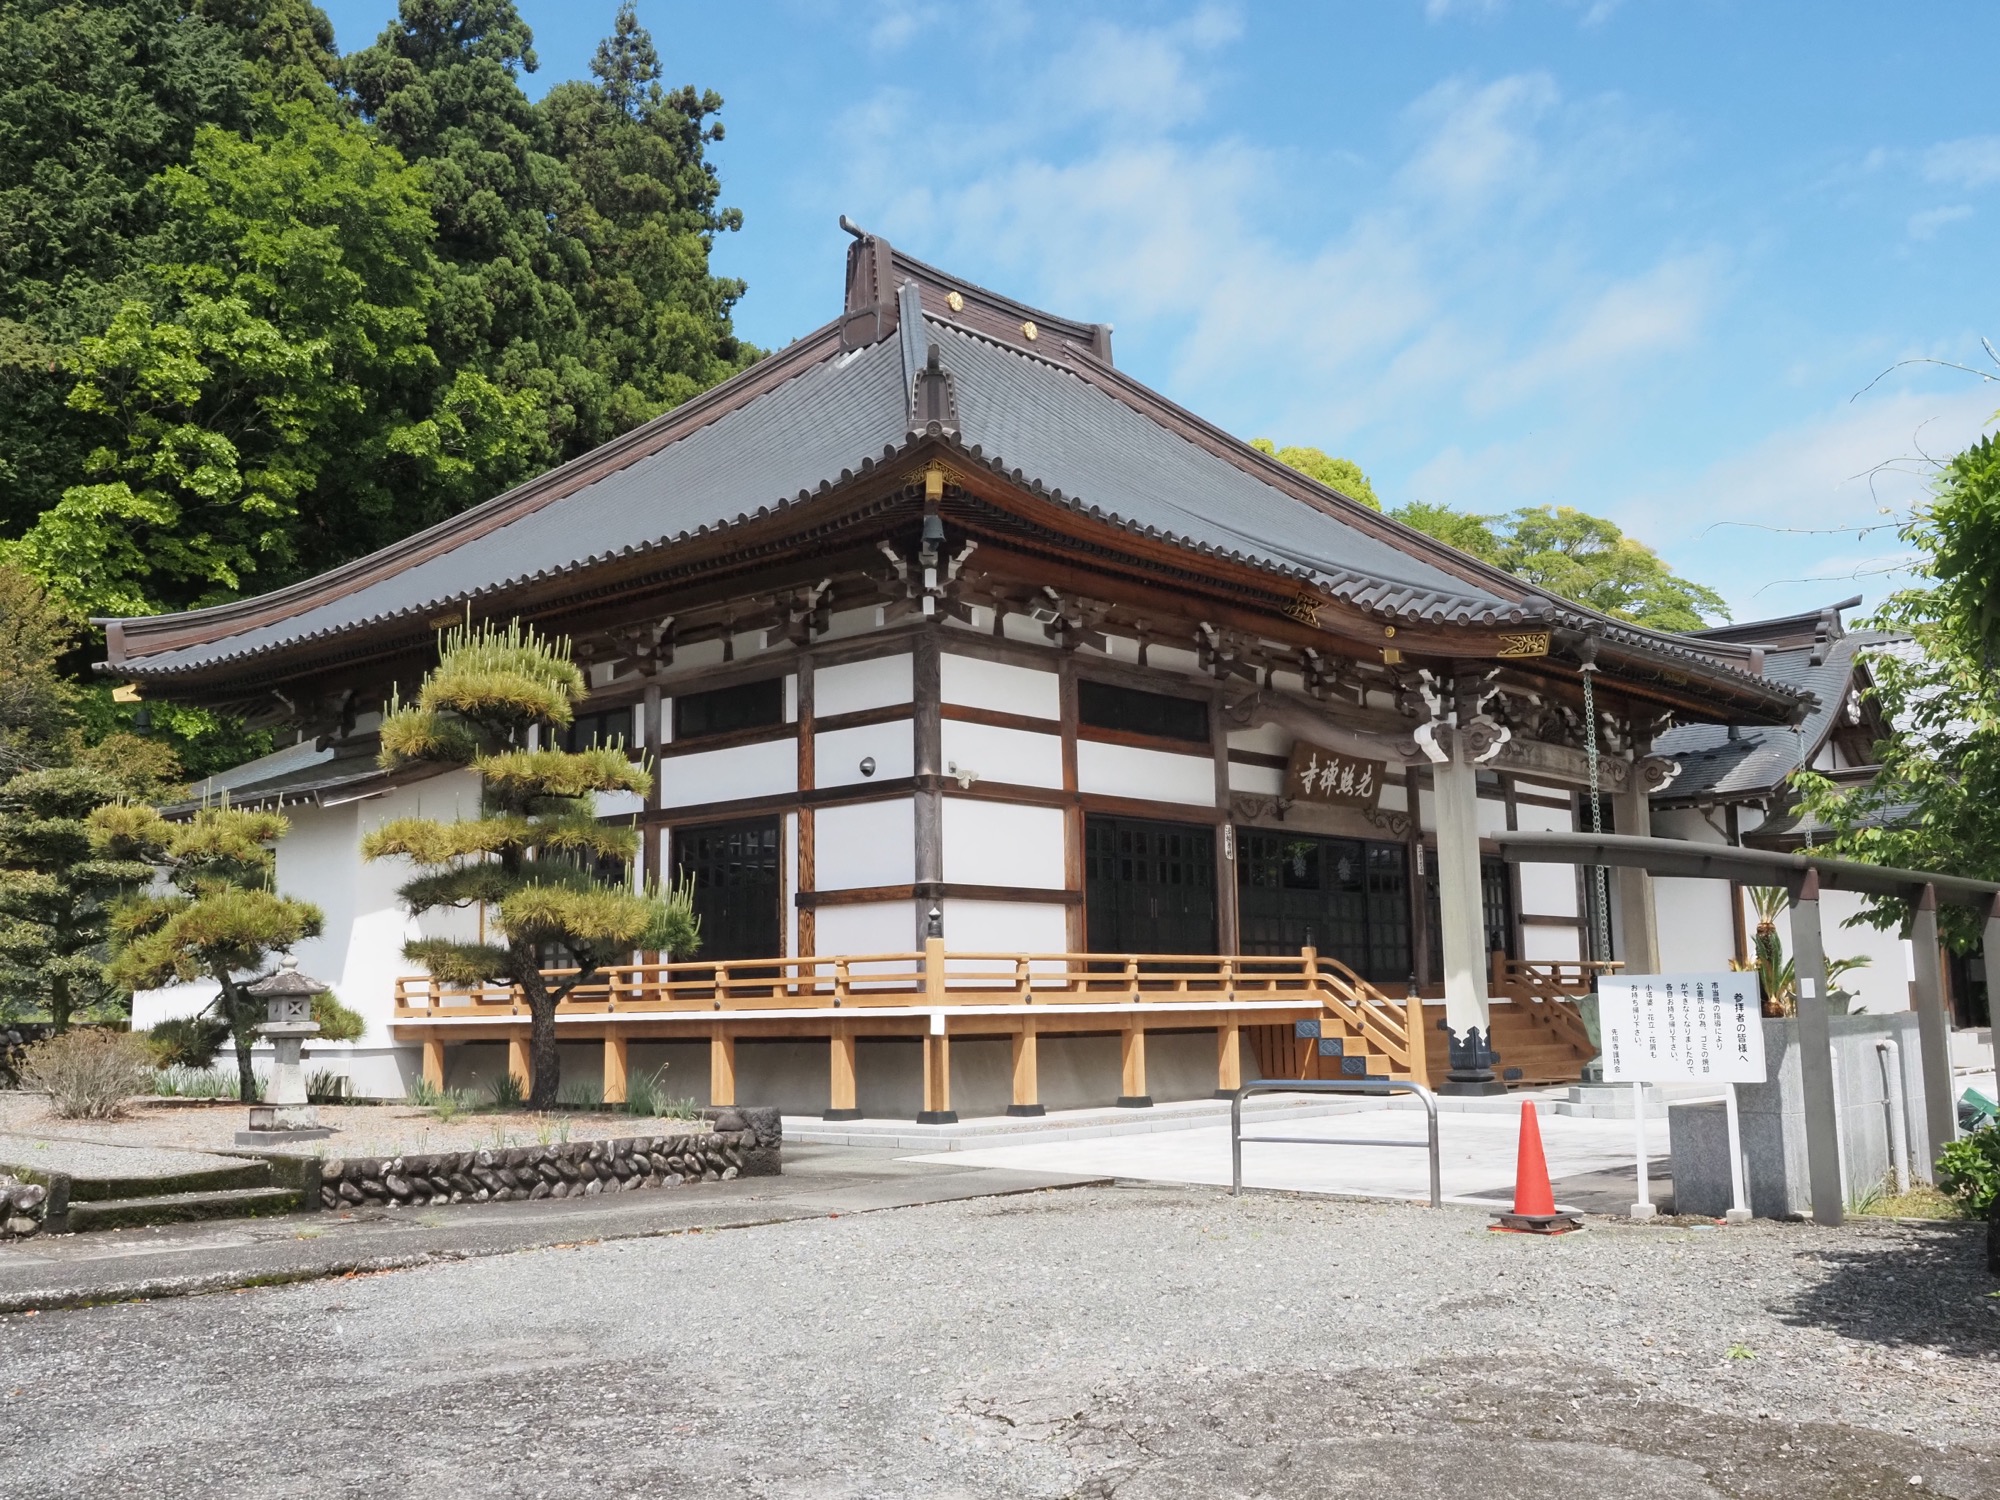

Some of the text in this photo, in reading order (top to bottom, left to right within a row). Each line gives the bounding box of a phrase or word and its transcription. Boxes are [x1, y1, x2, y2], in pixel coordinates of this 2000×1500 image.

[1630, 984, 1642, 1047] お持ち帰り下さい。
[1666, 983, 1679, 1062] 各自お持ち帰り下さい。
[1711, 982, 1723, 1051] 市当局の指導により
[1734, 992, 1749, 1062] 参拝者の皆様へ
